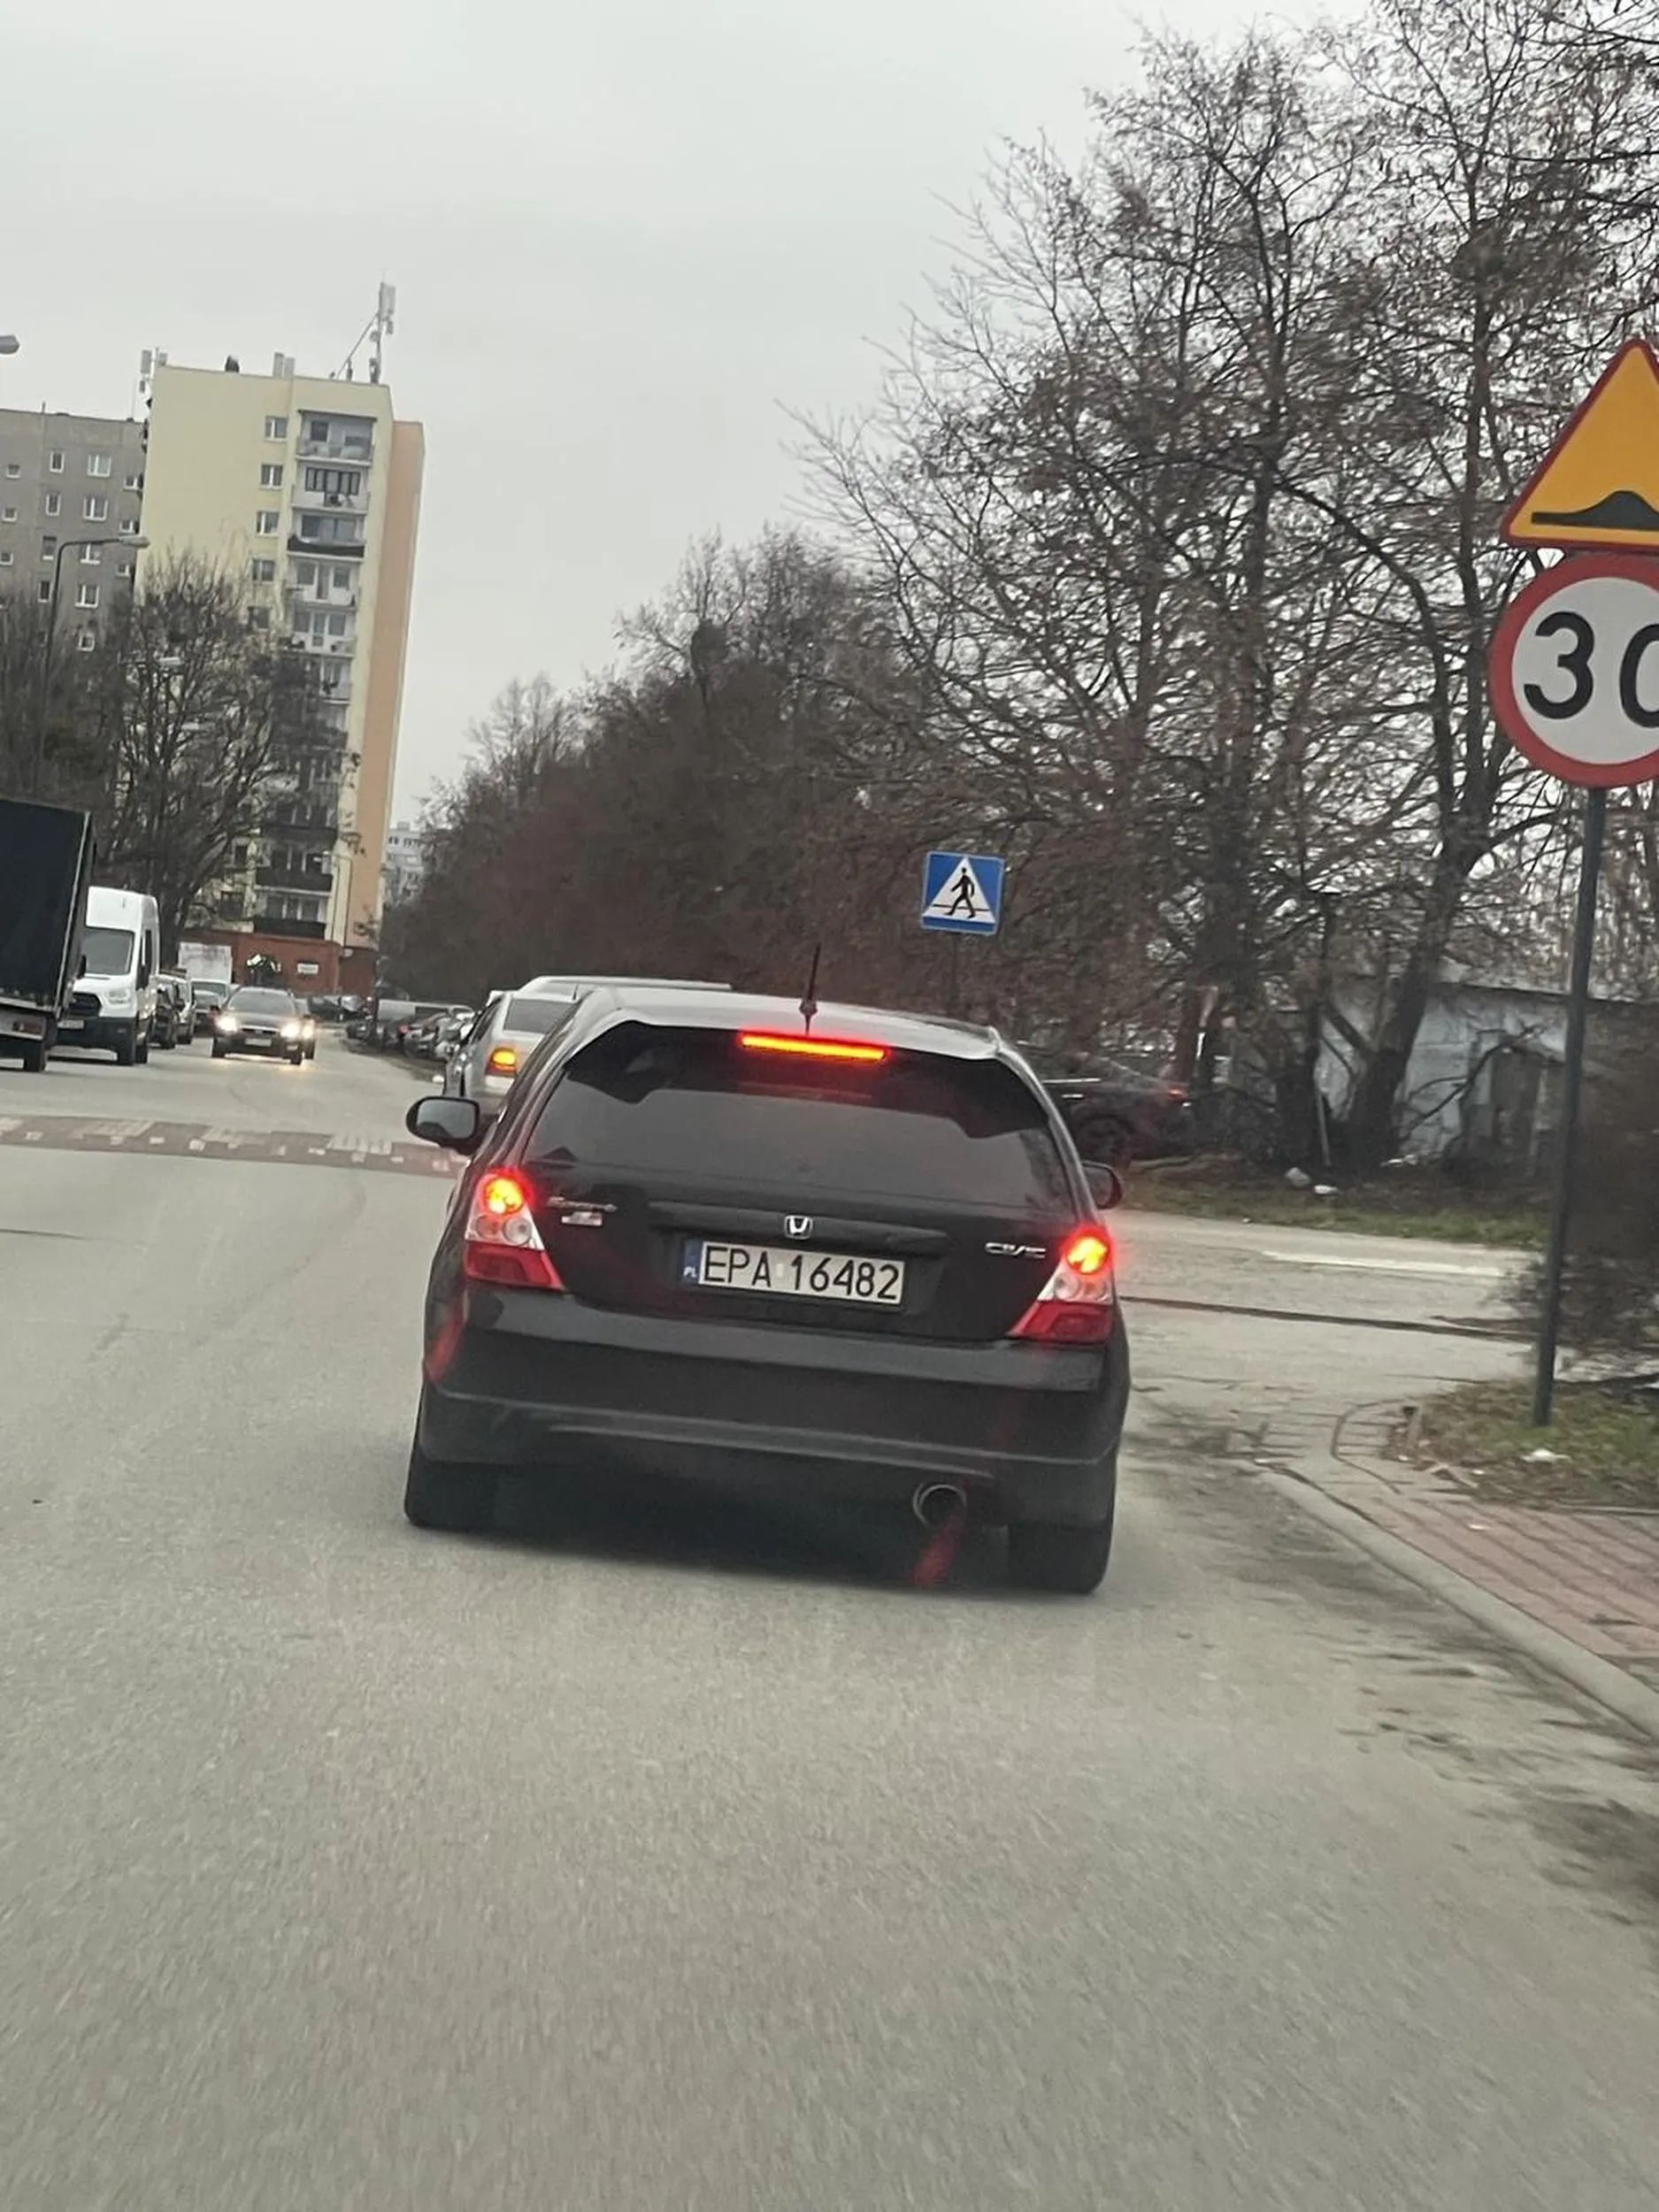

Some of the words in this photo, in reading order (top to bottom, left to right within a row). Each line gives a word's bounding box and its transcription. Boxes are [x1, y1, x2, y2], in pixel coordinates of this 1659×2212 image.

[1523, 611, 1659, 728] 30
[682, 1265, 698, 1279] PL
[703, 1245, 772, 1287] EPA
[790, 1254, 900, 1301] 16482
